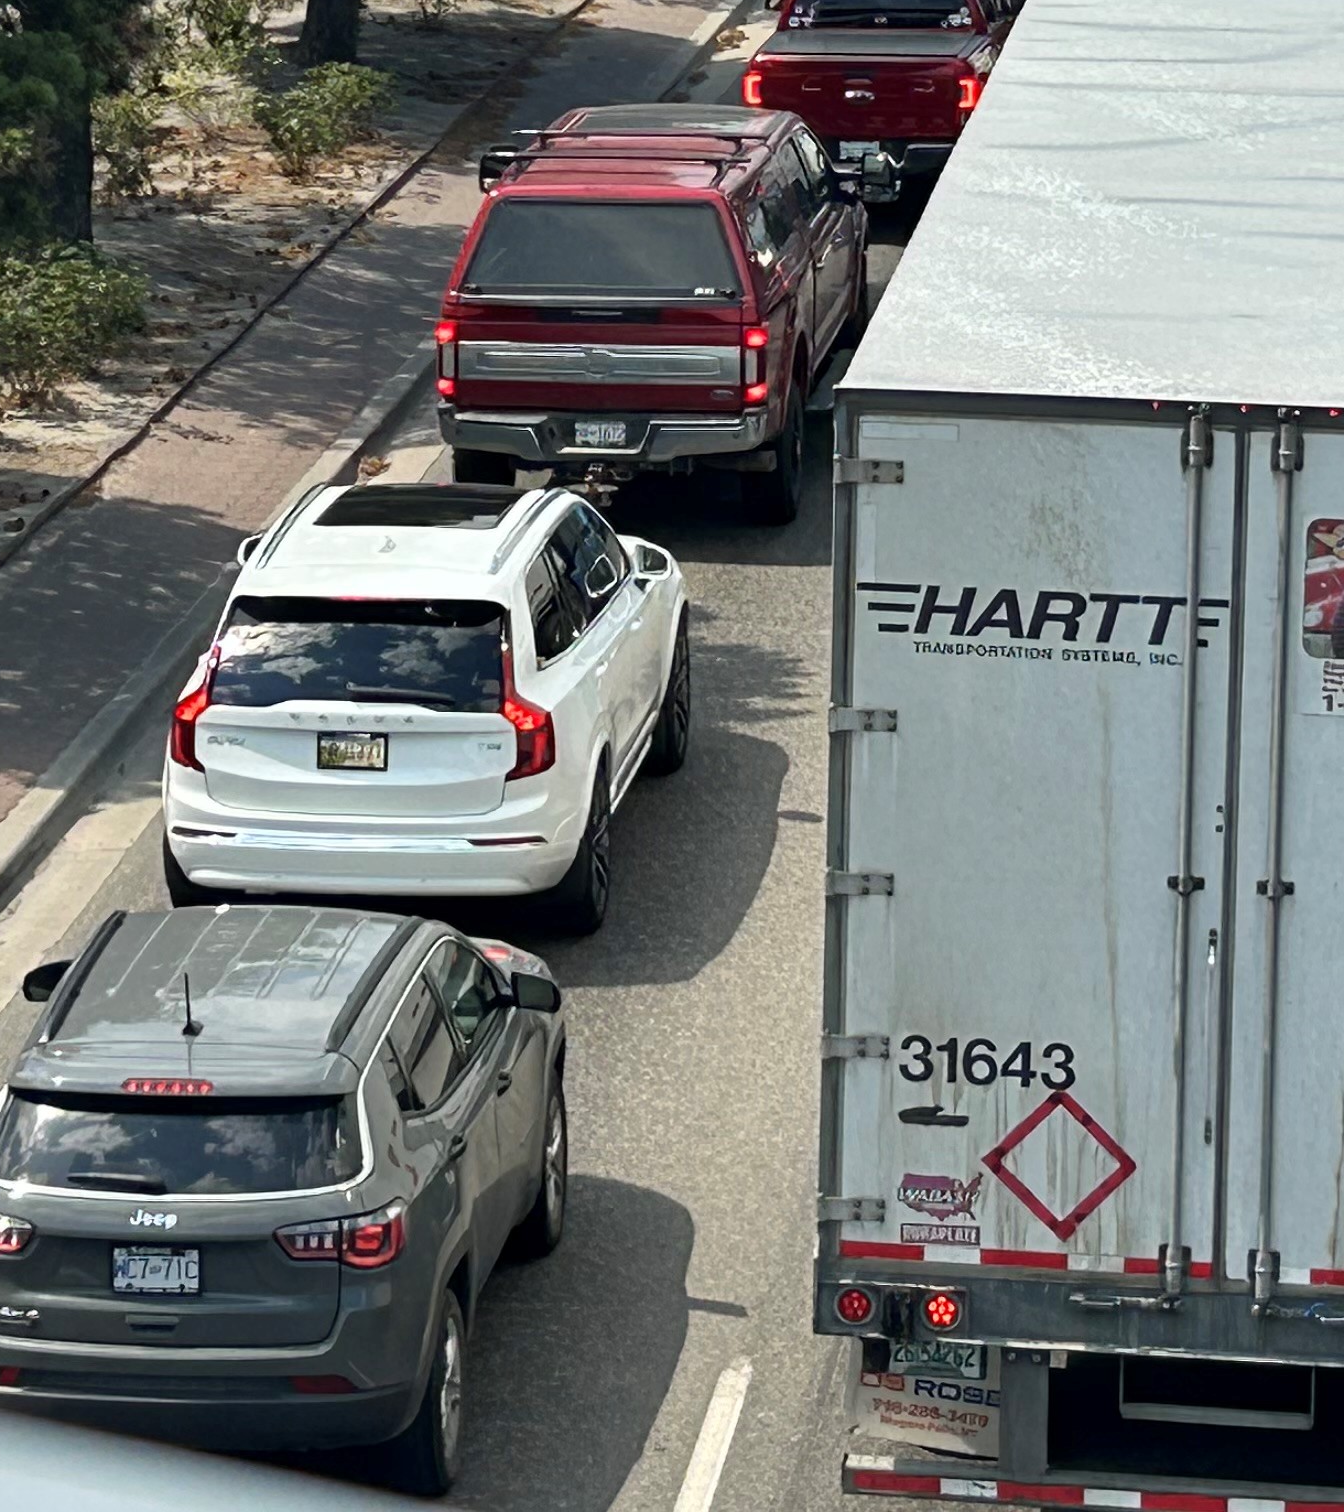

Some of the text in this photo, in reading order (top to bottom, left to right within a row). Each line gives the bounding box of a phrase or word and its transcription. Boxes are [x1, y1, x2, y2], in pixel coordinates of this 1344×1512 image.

[914, 585, 1188, 645] HARTT
[913, 641, 1053, 661] TRANSPORTATION
[899, 1035, 1076, 1090] 31643
[129, 1209, 177, 1229] Jeep
